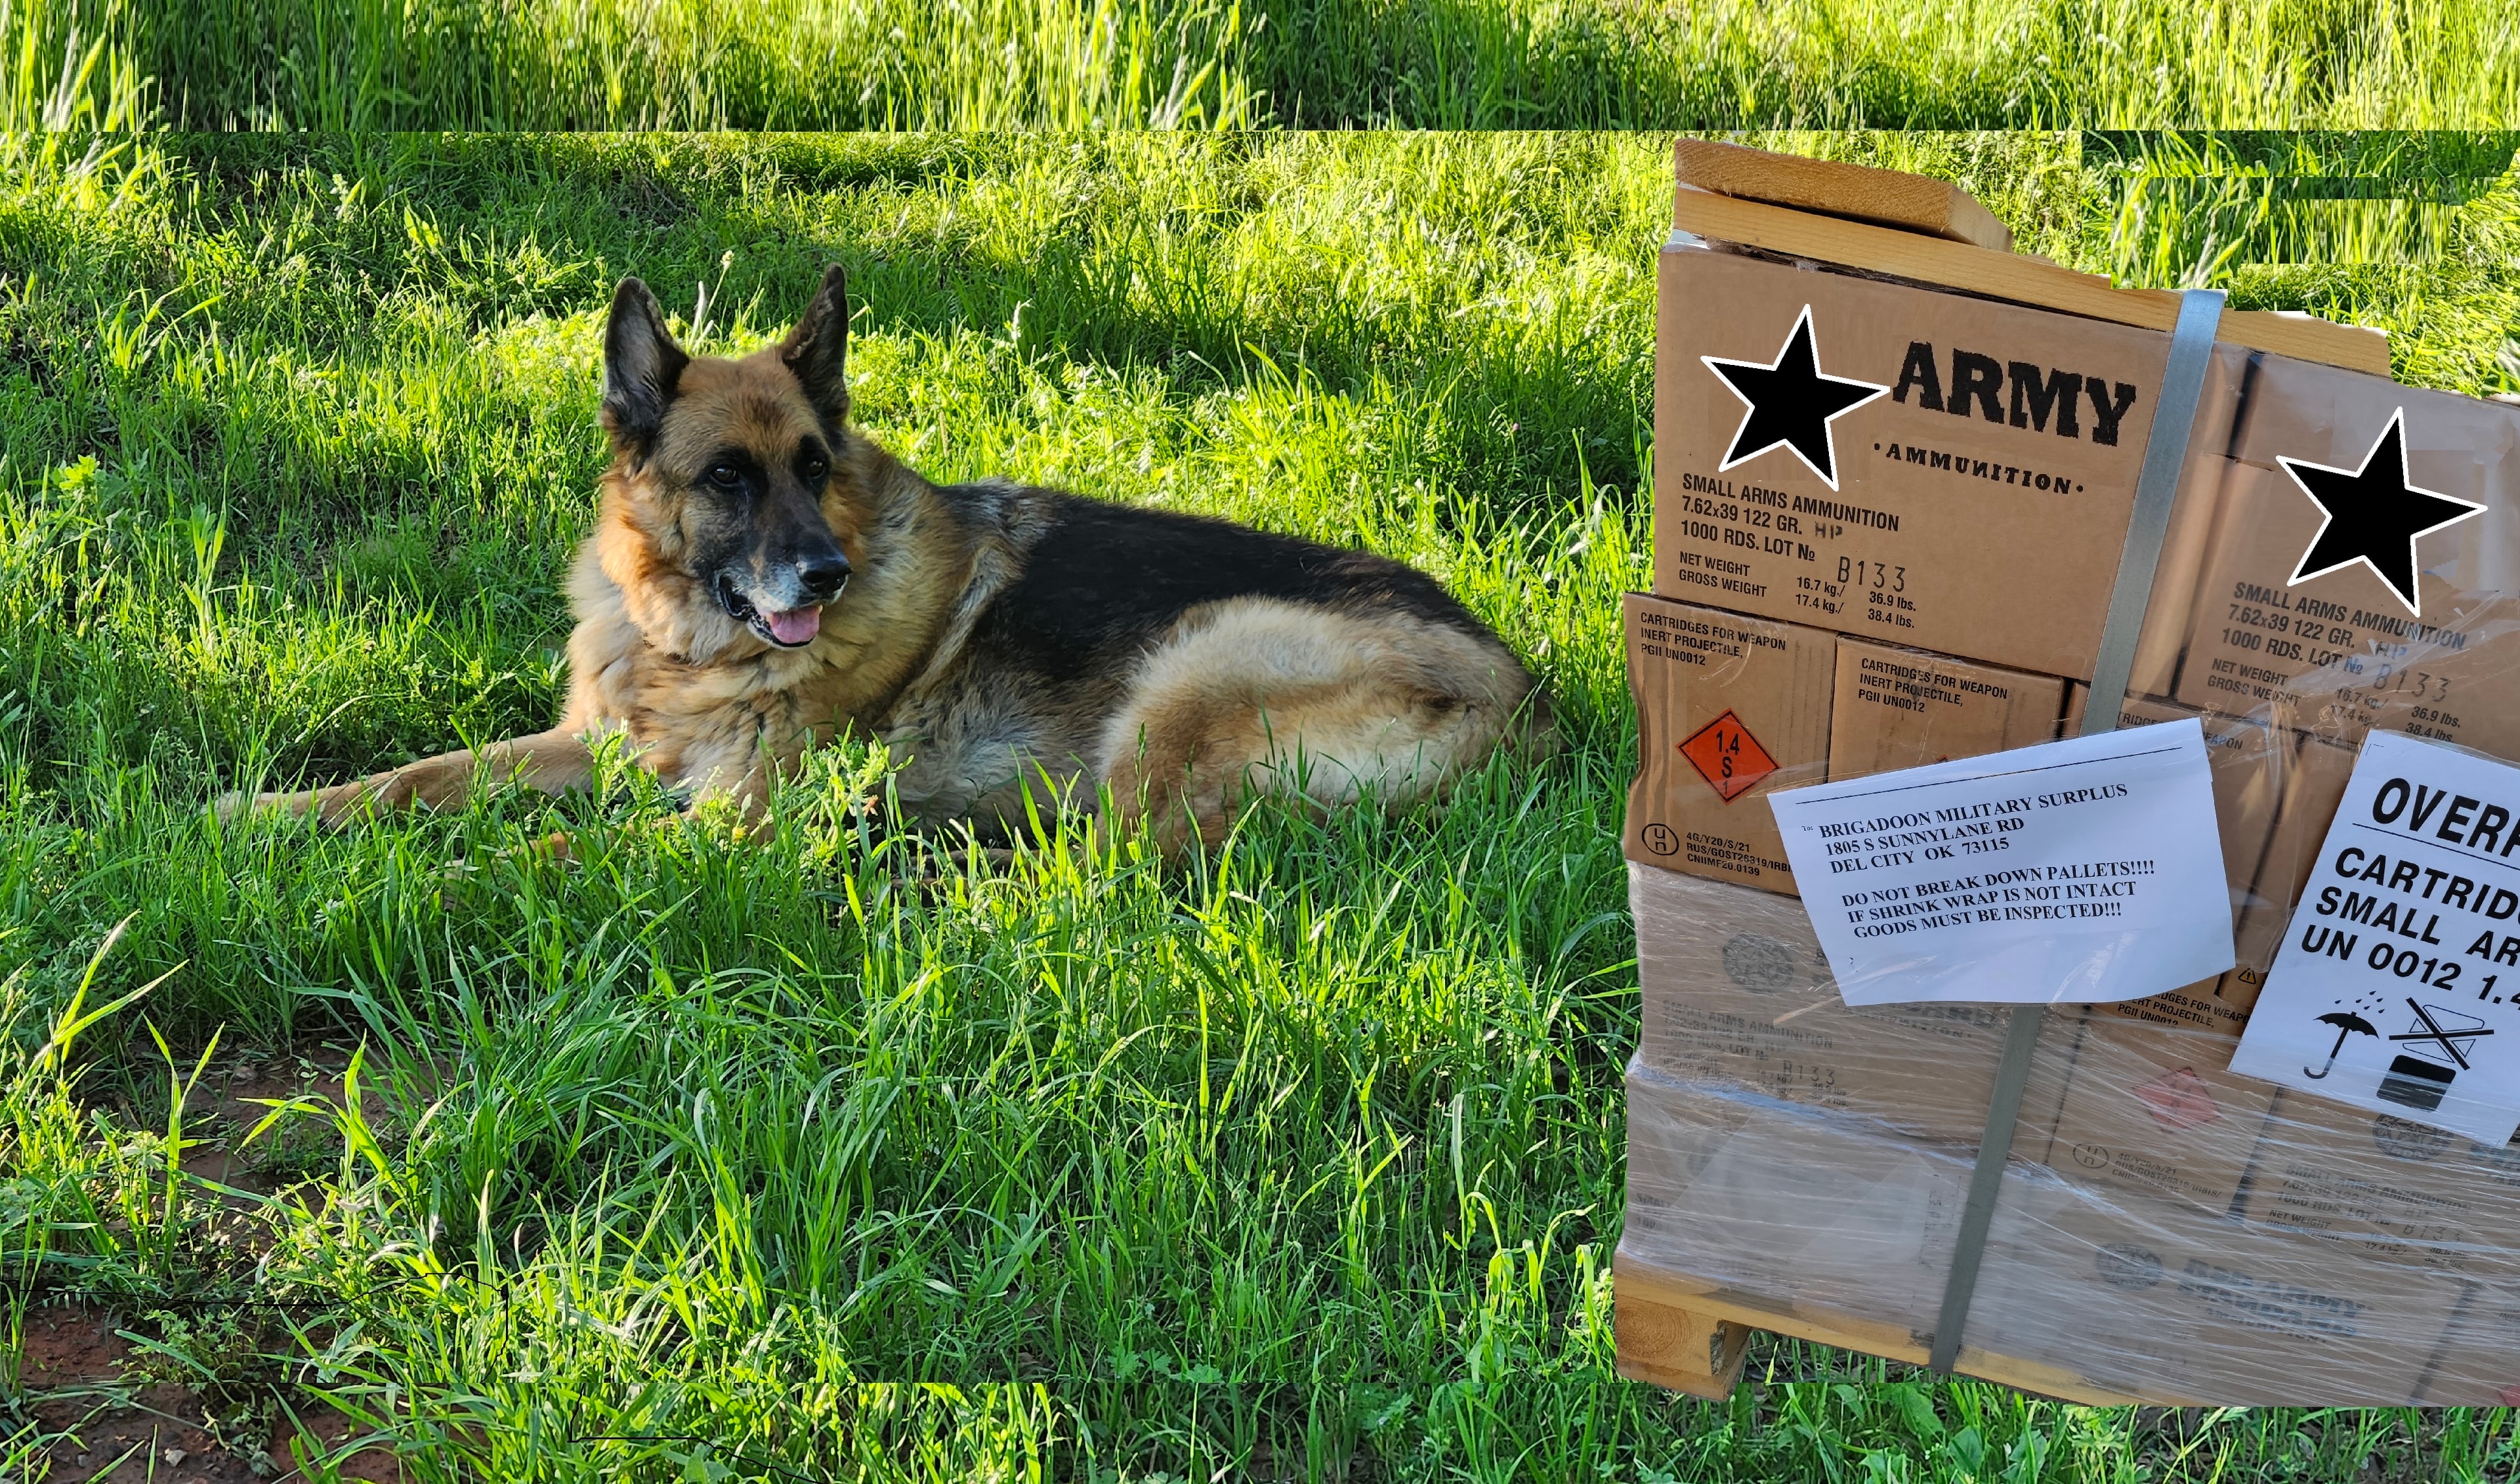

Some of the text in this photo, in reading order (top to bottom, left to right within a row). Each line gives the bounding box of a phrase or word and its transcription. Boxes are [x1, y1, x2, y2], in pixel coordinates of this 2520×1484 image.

[1893, 341, 2137, 446] ARMY
[1683, 473, 1899, 531] SMALL ARMS AMMUNITION
[1683, 495, 1843, 539] 7.62x39 122 GR. HP
[1681, 520, 1717, 541] 1000
[1724, 528, 1759, 550] RDS.
[1765, 537, 1793, 556] LOT
[1838, 556, 1906, 592] B133
[1679, 569, 1915, 629] GROSS WEIGHT 17.4 kg./ 38.4 lbs.
[1680, 551, 1916, 612] NET WEIGHT 16.7 kg./ 36.9 lbs.
[1641, 612, 1786, 650] CARTRIDGES FOR WEAPON
[2229, 604, 2289, 632] 7.62x39
[2294, 620, 2324, 640] 122
[2328, 627, 2355, 648] GR.
[2234, 582, 2467, 650] SMALL ARMS AMMUNITION
[1641, 628, 1743, 659] INERT PROJECTILE,
[1641, 644, 1705, 666] PGII UN0012
[2222, 628, 2261, 650] 1000
[2265, 638, 2303, 662] RDS.
[2311, 648, 2342, 669] LOT
[1860, 673, 1964, 707] INERT PROJECTILE,
[1862, 657, 2008, 700] CARTRIDGES FOR WEAPON
[2212, 658, 2236, 675] NET
[2240, 664, 2288, 685] WEIGHT
[2336, 689, 2362, 704] 16.7
[2411, 706, 2438, 722] 36.9
[2441, 712, 2462, 729] lbs.
[1858, 689, 1925, 712] PGII UN0012
[2208, 675, 2250, 694] GROSS
[2253, 685, 2301, 708] WEIGHT
[2405, 723, 2432, 737] 38.4
[1716, 730, 1740, 755] 1.4
[1721, 757, 1732, 778] S
[1819, 811, 1932, 839] BRIGADOON
[1936, 797, 2032, 823] MILITARY
[2038, 784, 2128, 809] SURPLUS
[1687, 832, 1750, 853] 4G/Y20/S/21
[1825, 818, 2025, 857] 1805 S SUNNYLANE RD
[1830, 837, 2009, 874] DEL CITY OK 73115
[1841, 860, 2154, 908] DO NOT BREAK DOWN PALLETS!!!!
[1847, 881, 2136, 923] IF SHRINK WRAP IS NOT INTACT
[2335, 847, 2520, 926] CARTRID
[1854, 902, 2122, 939] GOODS MUST BE INSPECTED!!!
[2316, 886, 2441, 946] SMALL
[2301, 924, 2358, 961] UN
[2368, 943, 2462, 991] 0012
[2153, 1001, 2214, 1028] PROJECTILE,
[2191, 1000, 2211, 1012] FOR
[1708, 1012, 1745, 1028] ARMS
[1749, 1021, 1833, 1049] AMMUNITION
[1729, 1044, 1751, 1057] LOT
[1783, 1059, 1836, 1086] B133
[2269, 1209, 2288, 1221] NET
[2291, 1214, 2332, 1229] WEIGHT
